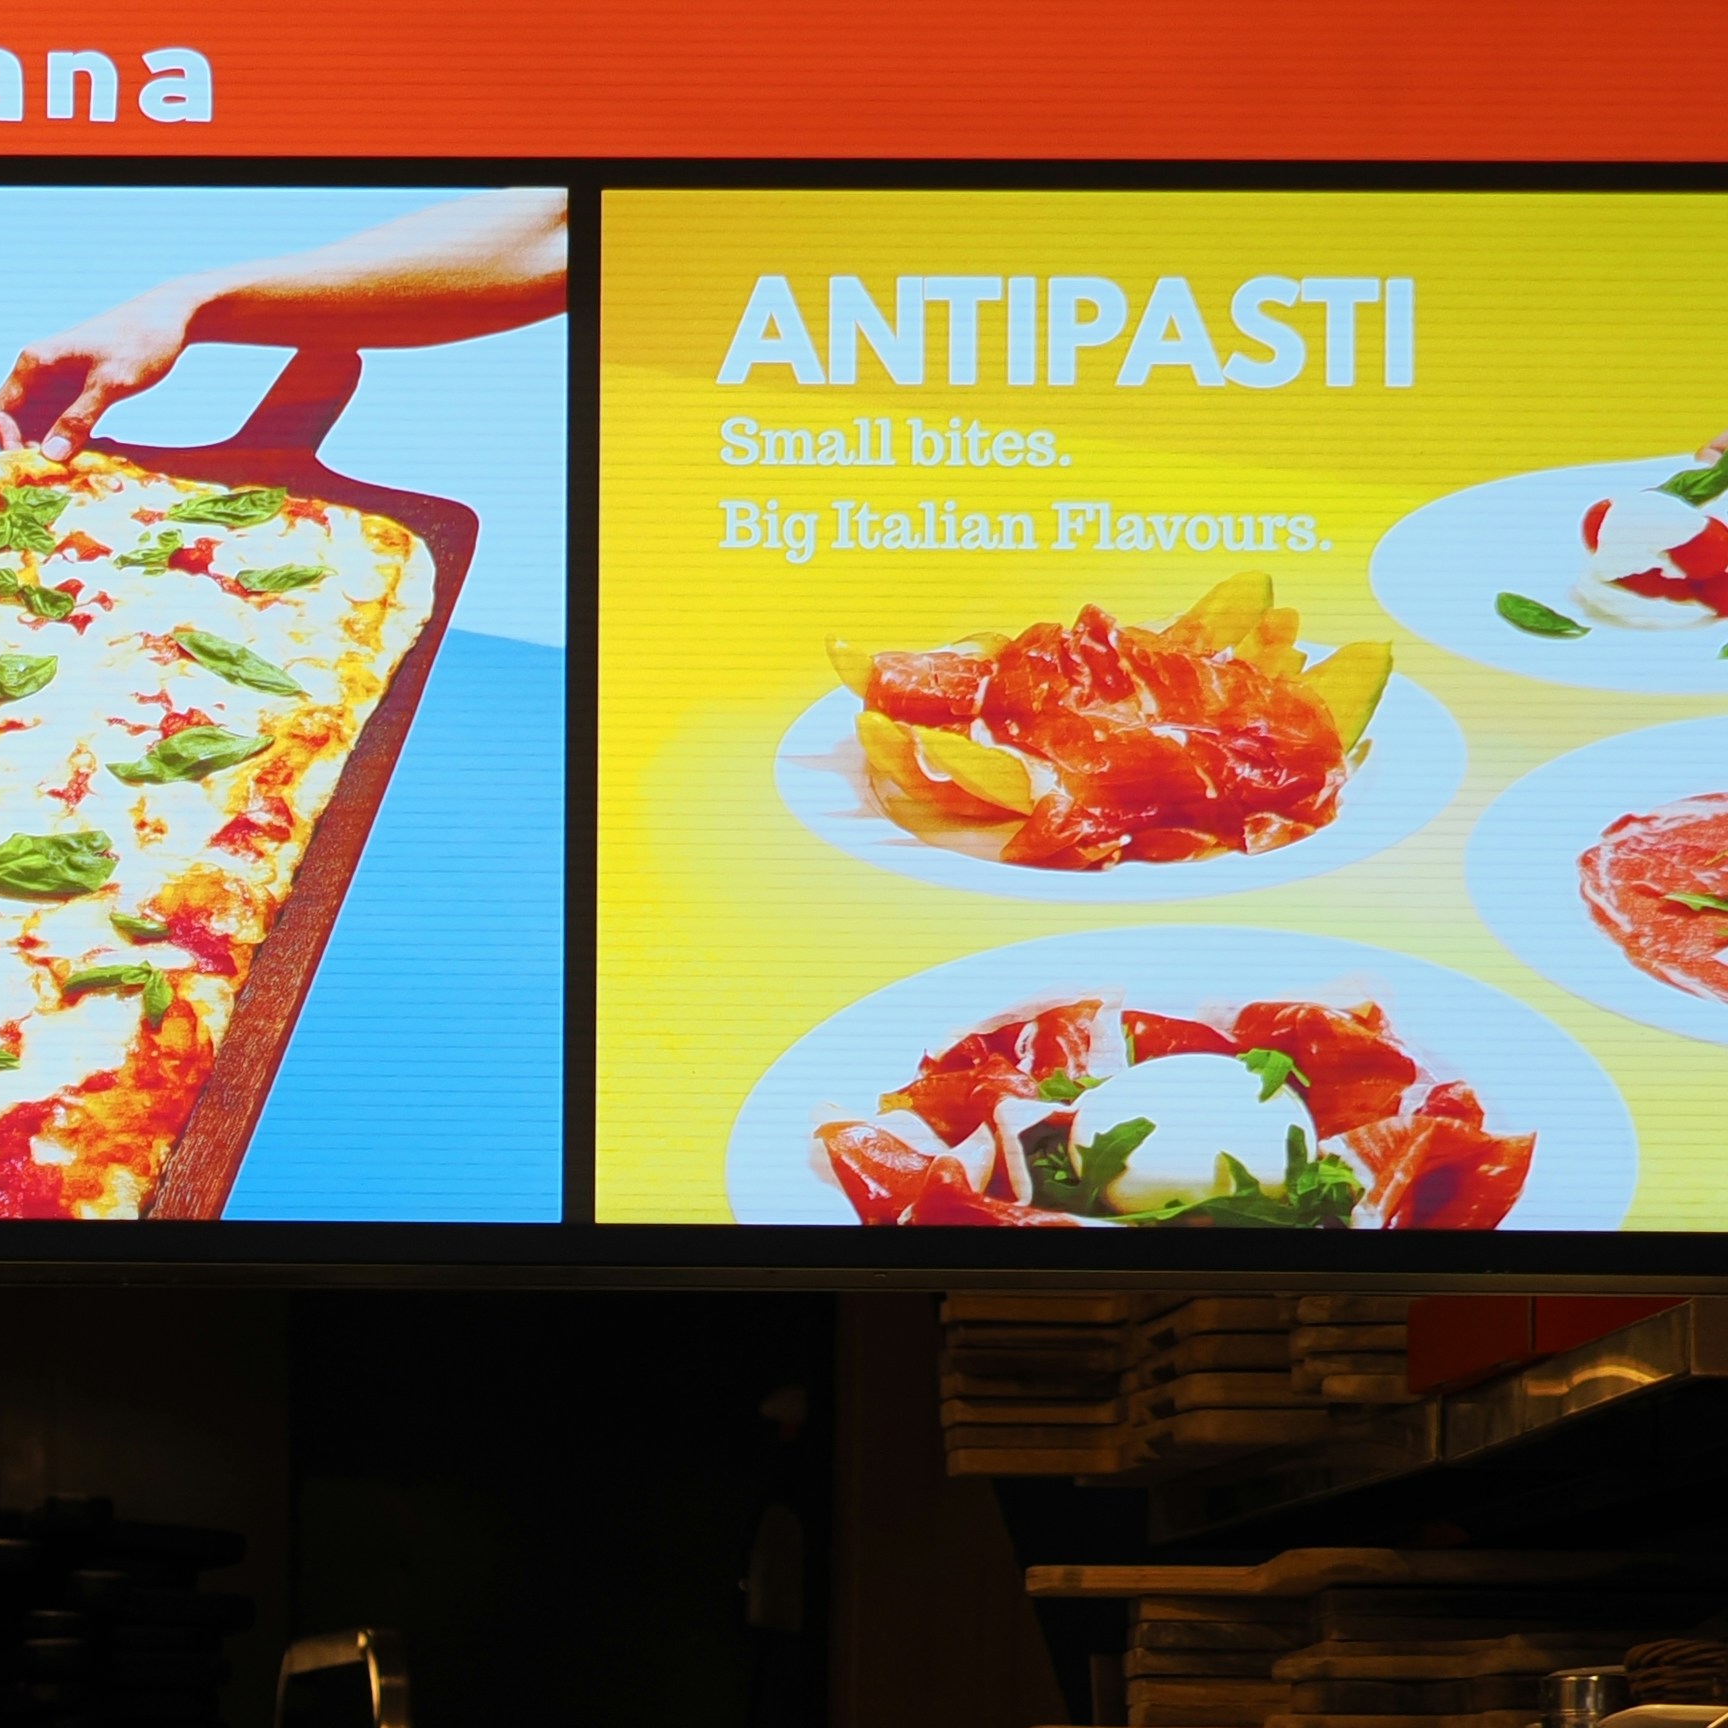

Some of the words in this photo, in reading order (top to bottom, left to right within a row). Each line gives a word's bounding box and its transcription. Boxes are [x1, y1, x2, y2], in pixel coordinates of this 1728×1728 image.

[715, 275, 1415, 388] ANTIPASTI
[719, 416, 894, 467] Small
[907, 418, 1072, 467] bites.
[719, 500, 818, 563] Big
[829, 500, 1038, 551] Italian
[1049, 501, 1333, 552] Flavours.
